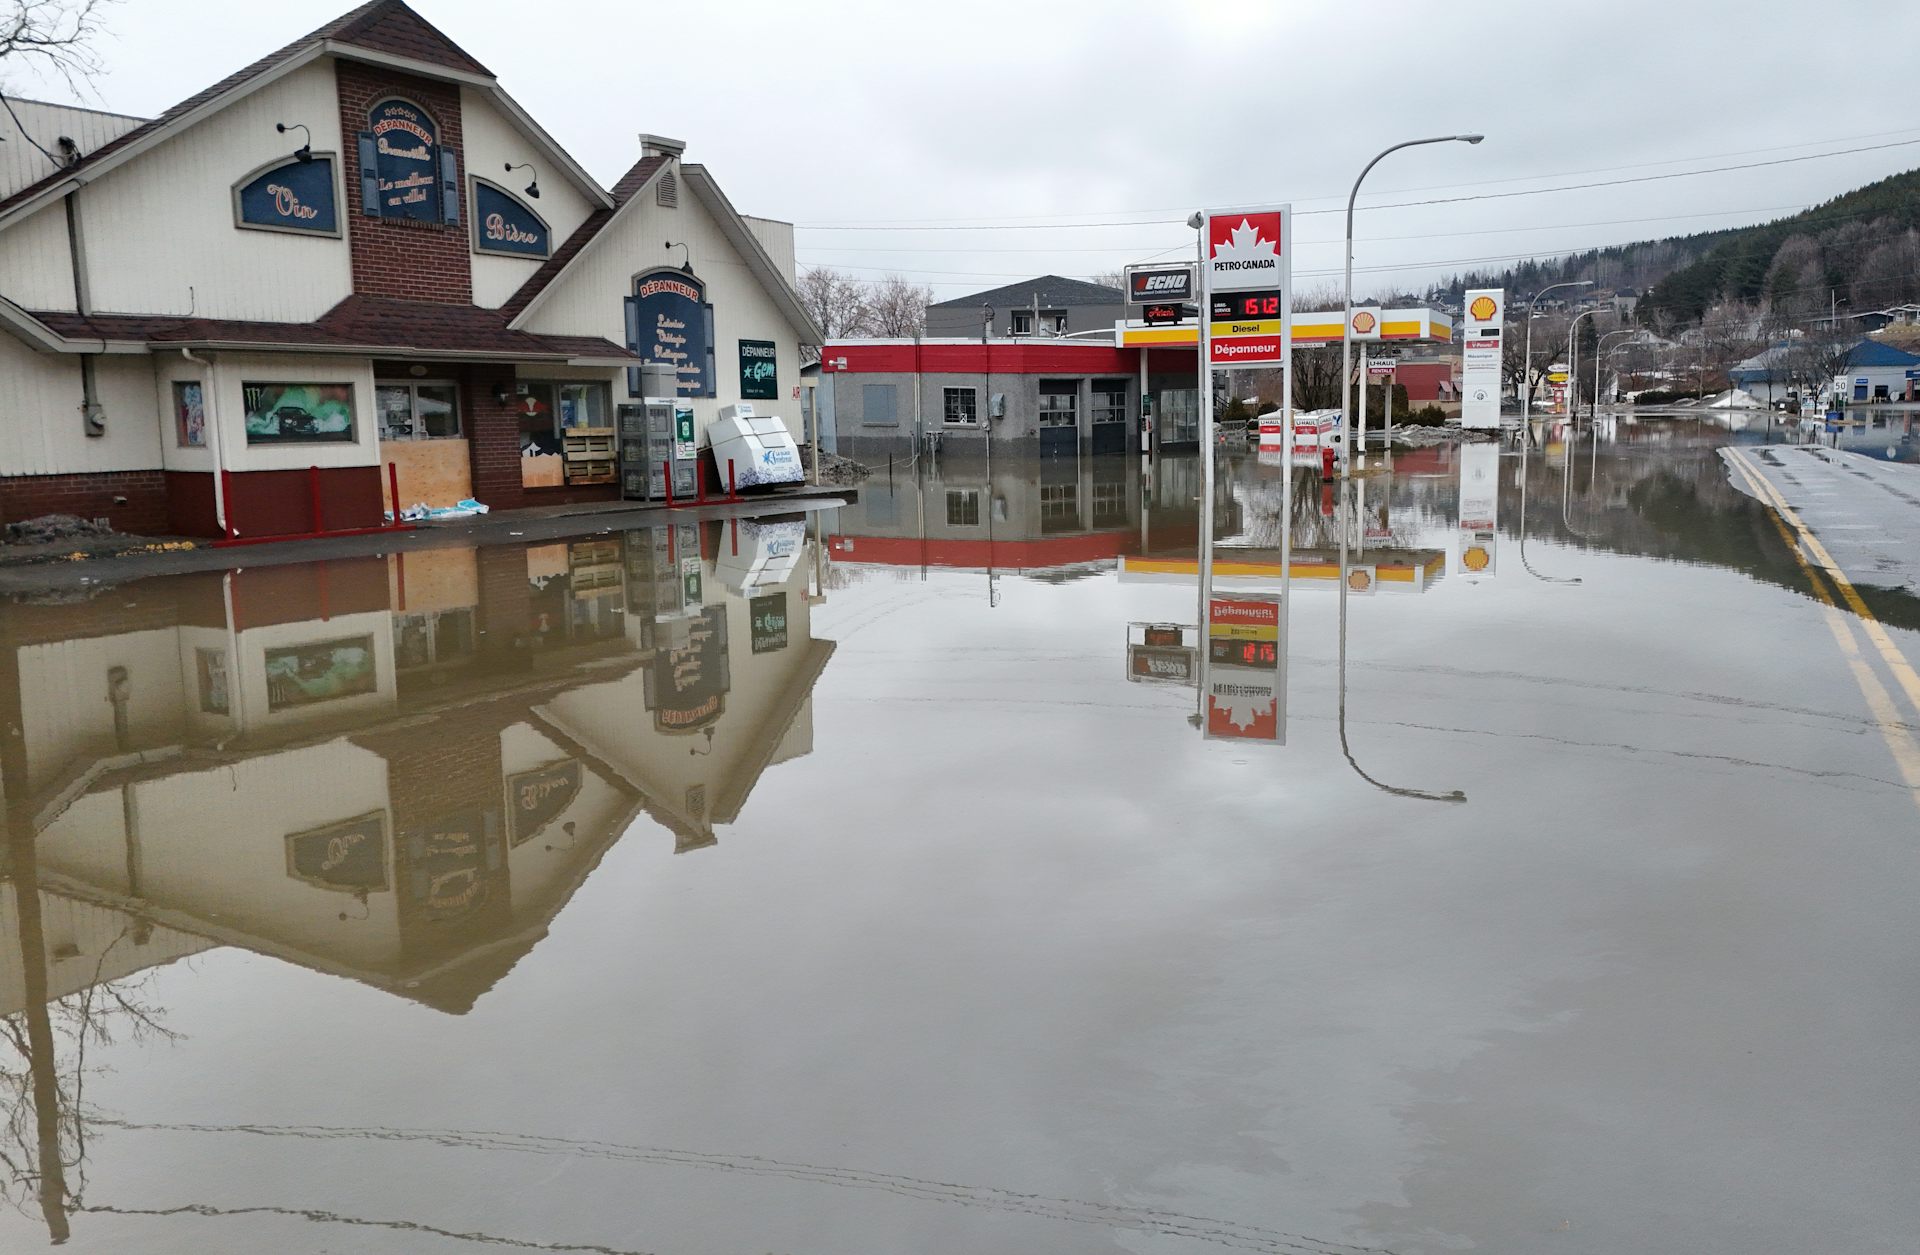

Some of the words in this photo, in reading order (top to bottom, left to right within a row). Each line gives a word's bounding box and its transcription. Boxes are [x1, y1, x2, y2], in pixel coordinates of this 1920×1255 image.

[374, 119, 432, 147] DÉPANNEUR
[379, 178, 393, 191] Le
[267, 184, 318, 218] Vin
[486, 213, 538, 243] Bière
[1145, 274, 1187, 290] ECHO
[640, 280, 698, 302] DÉPANNEUR
[1232, 325, 1260, 333] Diesel
[741, 344, 776, 358] DÉPANNEUR
[1214, 344, 1277, 357] Dépanneur
[1835, 382, 1846, 390] 50
